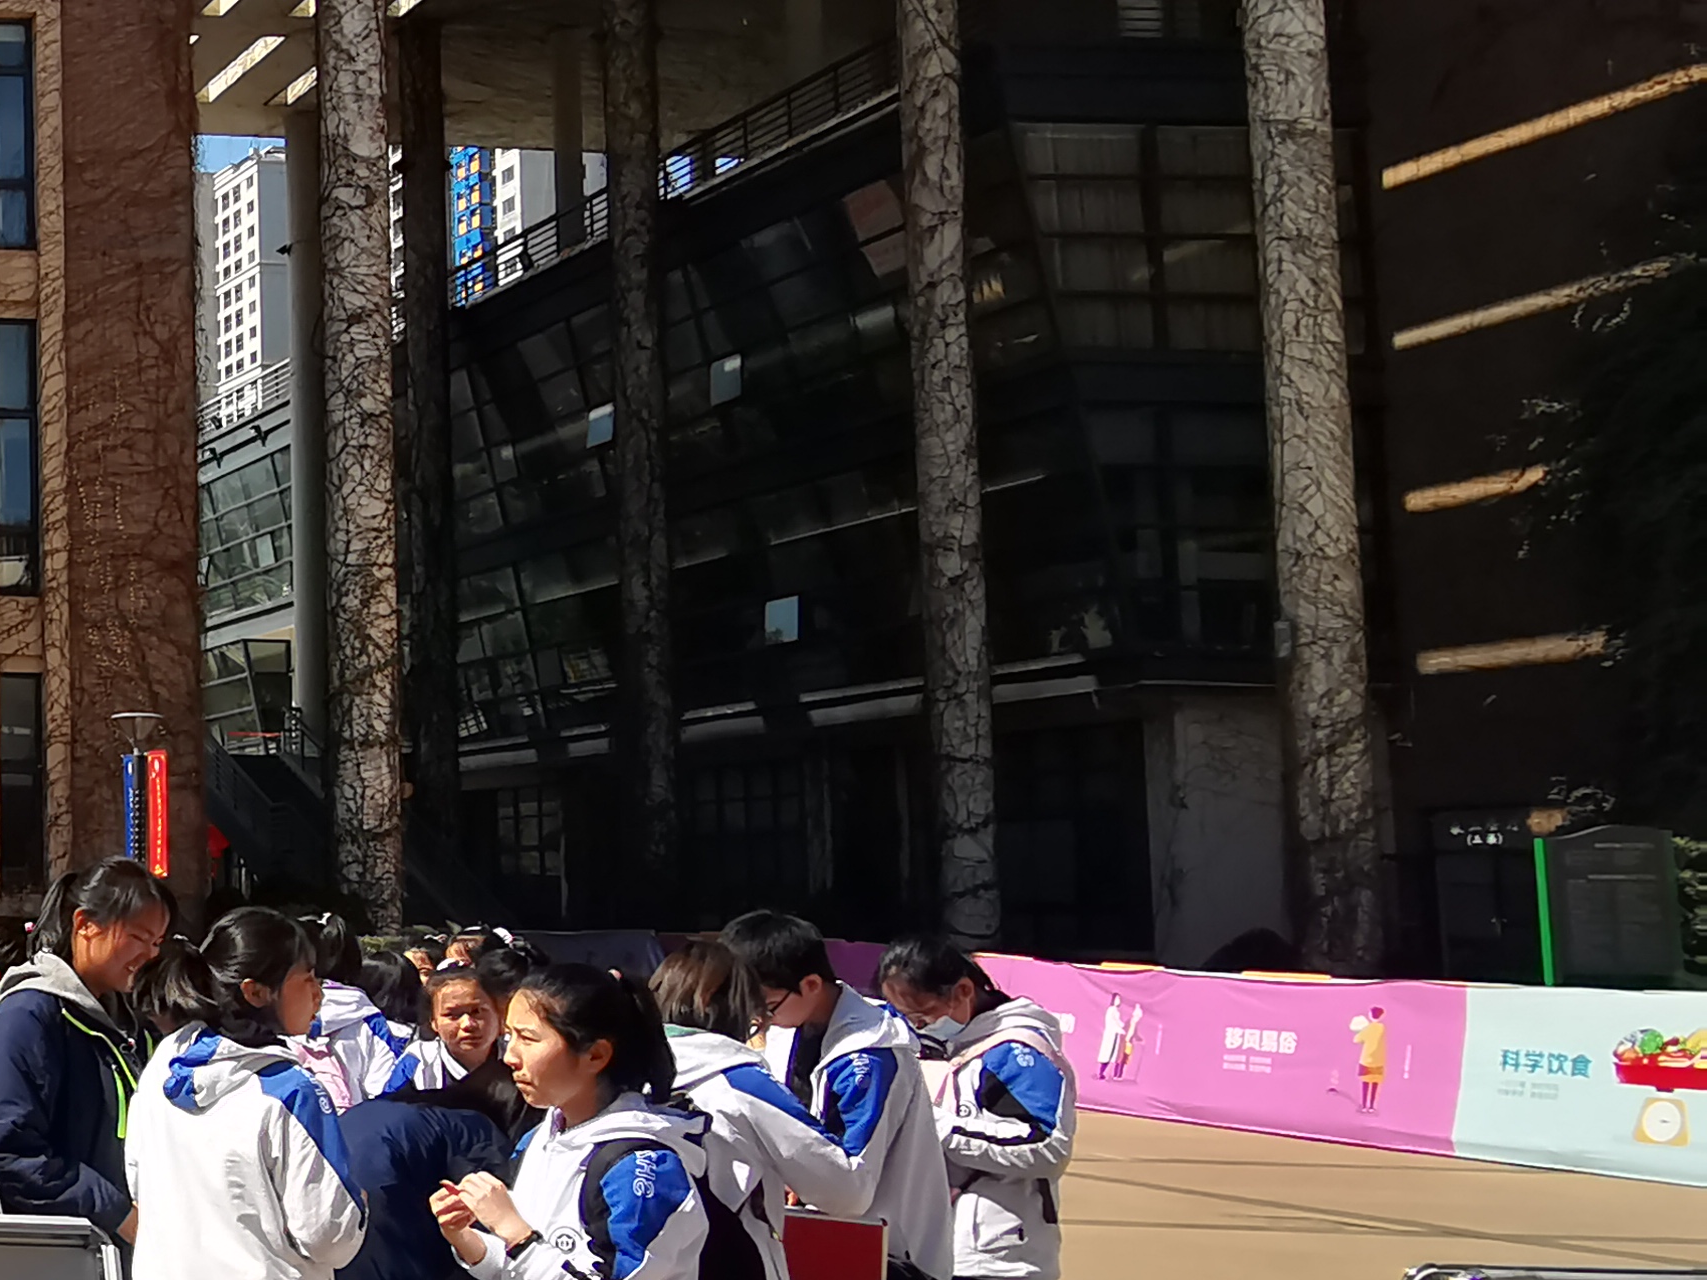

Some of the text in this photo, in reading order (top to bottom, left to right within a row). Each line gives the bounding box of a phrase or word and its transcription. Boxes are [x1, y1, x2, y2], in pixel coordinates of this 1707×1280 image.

[1224, 1026, 1298, 1055] 移风易俗
[1499, 1048, 1593, 1079] 科学饮食
